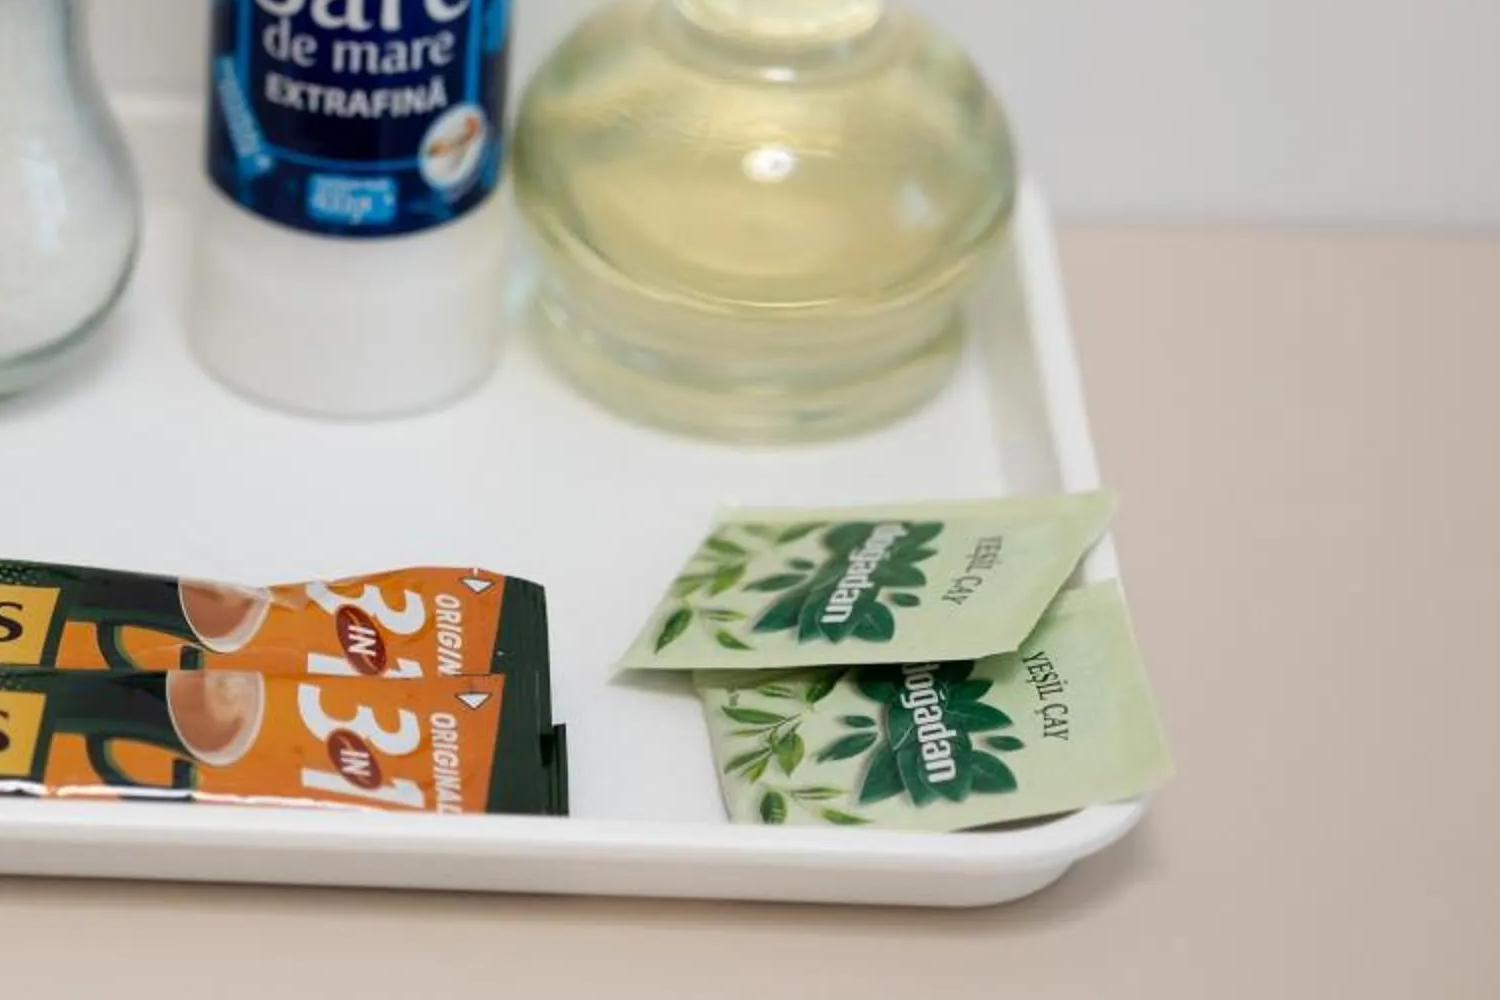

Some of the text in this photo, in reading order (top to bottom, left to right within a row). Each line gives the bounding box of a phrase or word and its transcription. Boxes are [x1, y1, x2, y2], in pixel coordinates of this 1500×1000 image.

[262, 17, 455, 75] de mare
[347, 624, 377, 657] IN
[297, 684, 421, 757] 3
[1034, 703, 1069, 741] ÇAY
[339, 748, 372, 777] IN
